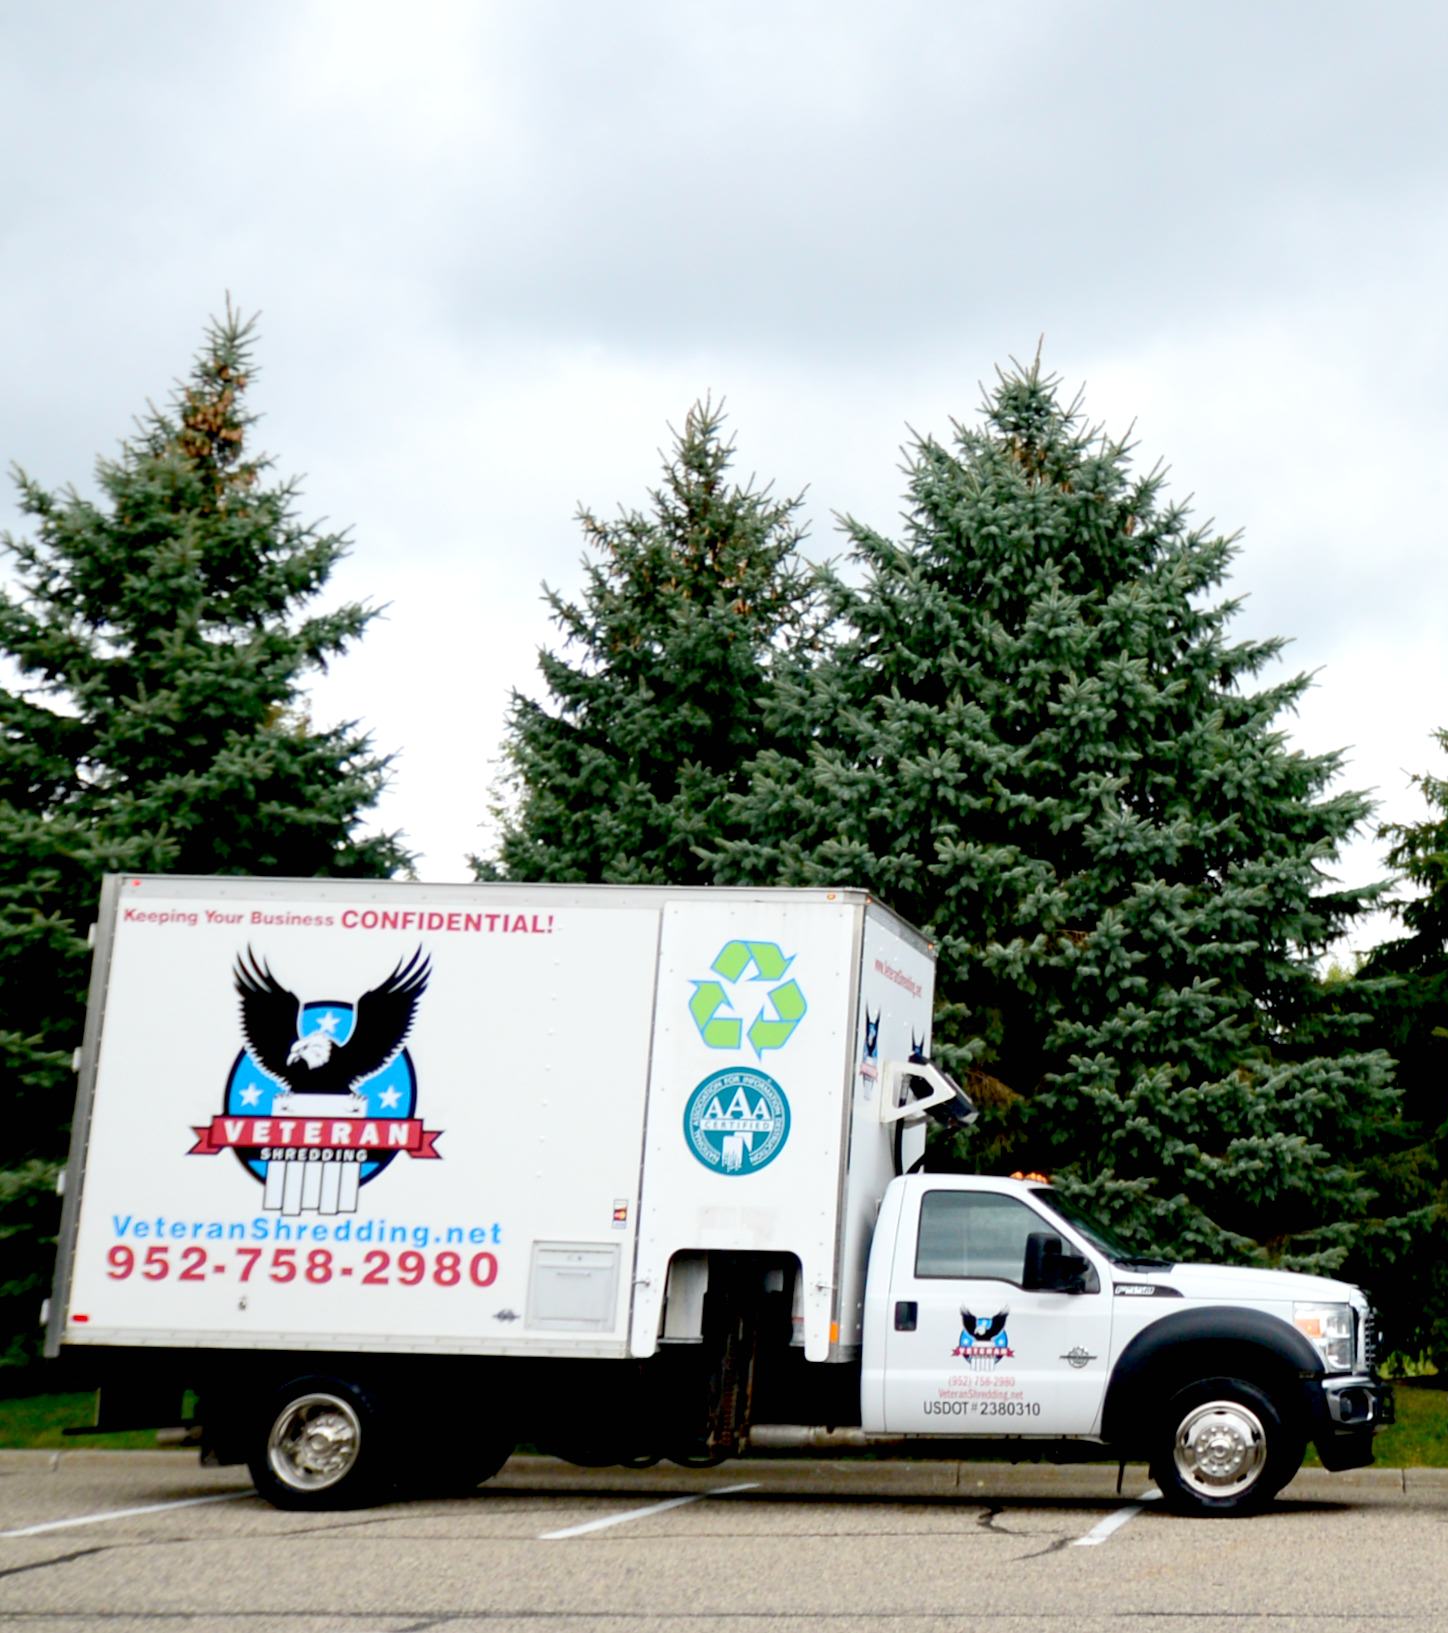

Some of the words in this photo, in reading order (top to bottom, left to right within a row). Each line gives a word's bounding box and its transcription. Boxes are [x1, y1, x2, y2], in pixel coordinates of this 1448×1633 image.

[123, 908, 199, 926] Keeping
[204, 910, 244, 924] Your
[250, 911, 335, 926] Business
[341, 910, 555, 934] CONFIDENTIAL!
[703, 1086, 772, 1120] AAA
[224, 1120, 410, 1146] VETERAN
[704, 1120, 770, 1131] CERTIFIED
[260, 1148, 368, 1162] SHREDDING
[112, 1215, 502, 1249] VeteranShredding.net
[106, 1245, 501, 1288] 952-758-2980
[923, 1401, 968, 1415] USDOT
[980, 1401, 1041, 1416] 2380310
